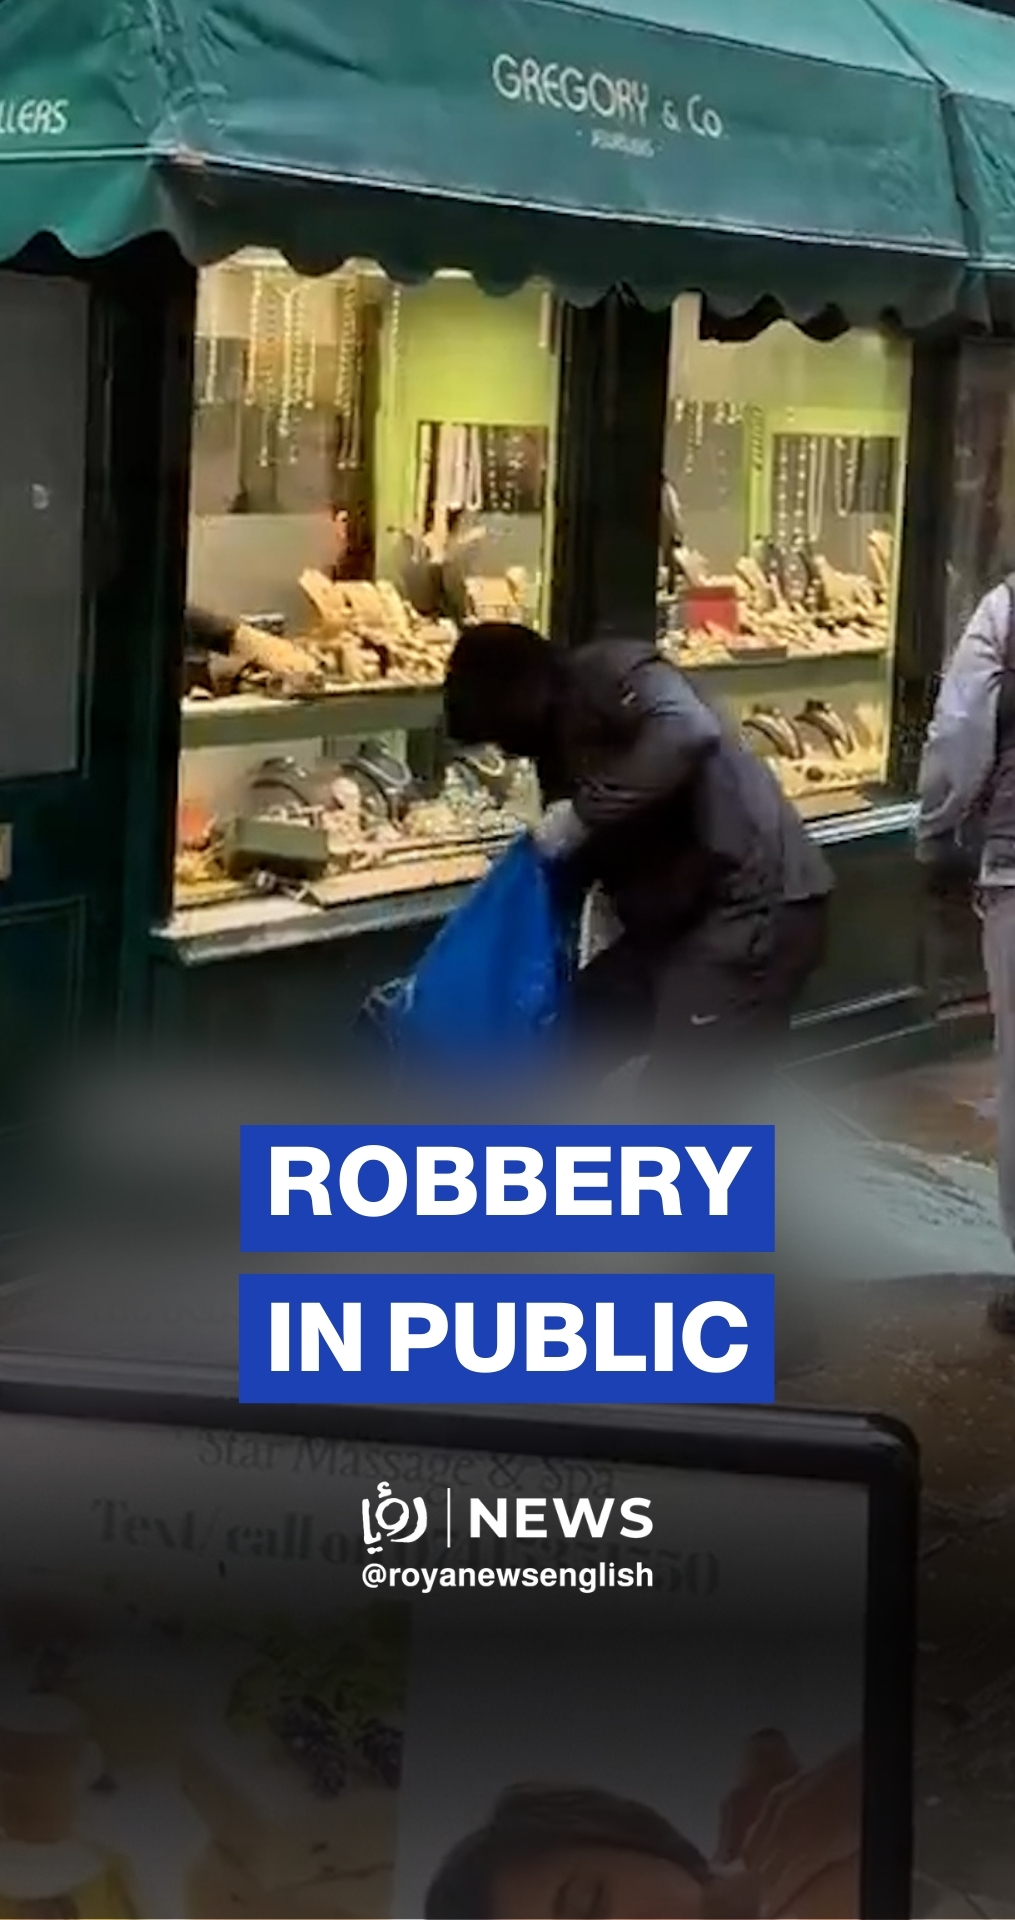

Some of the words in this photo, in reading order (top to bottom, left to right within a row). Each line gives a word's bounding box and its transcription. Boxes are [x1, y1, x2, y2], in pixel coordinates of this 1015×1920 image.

[492, 53, 649, 127] GREGORY
[662, 99, 681, 132] &
[292, 1437, 475, 1506] Massage
[539, 1456, 615, 1520] Spa
